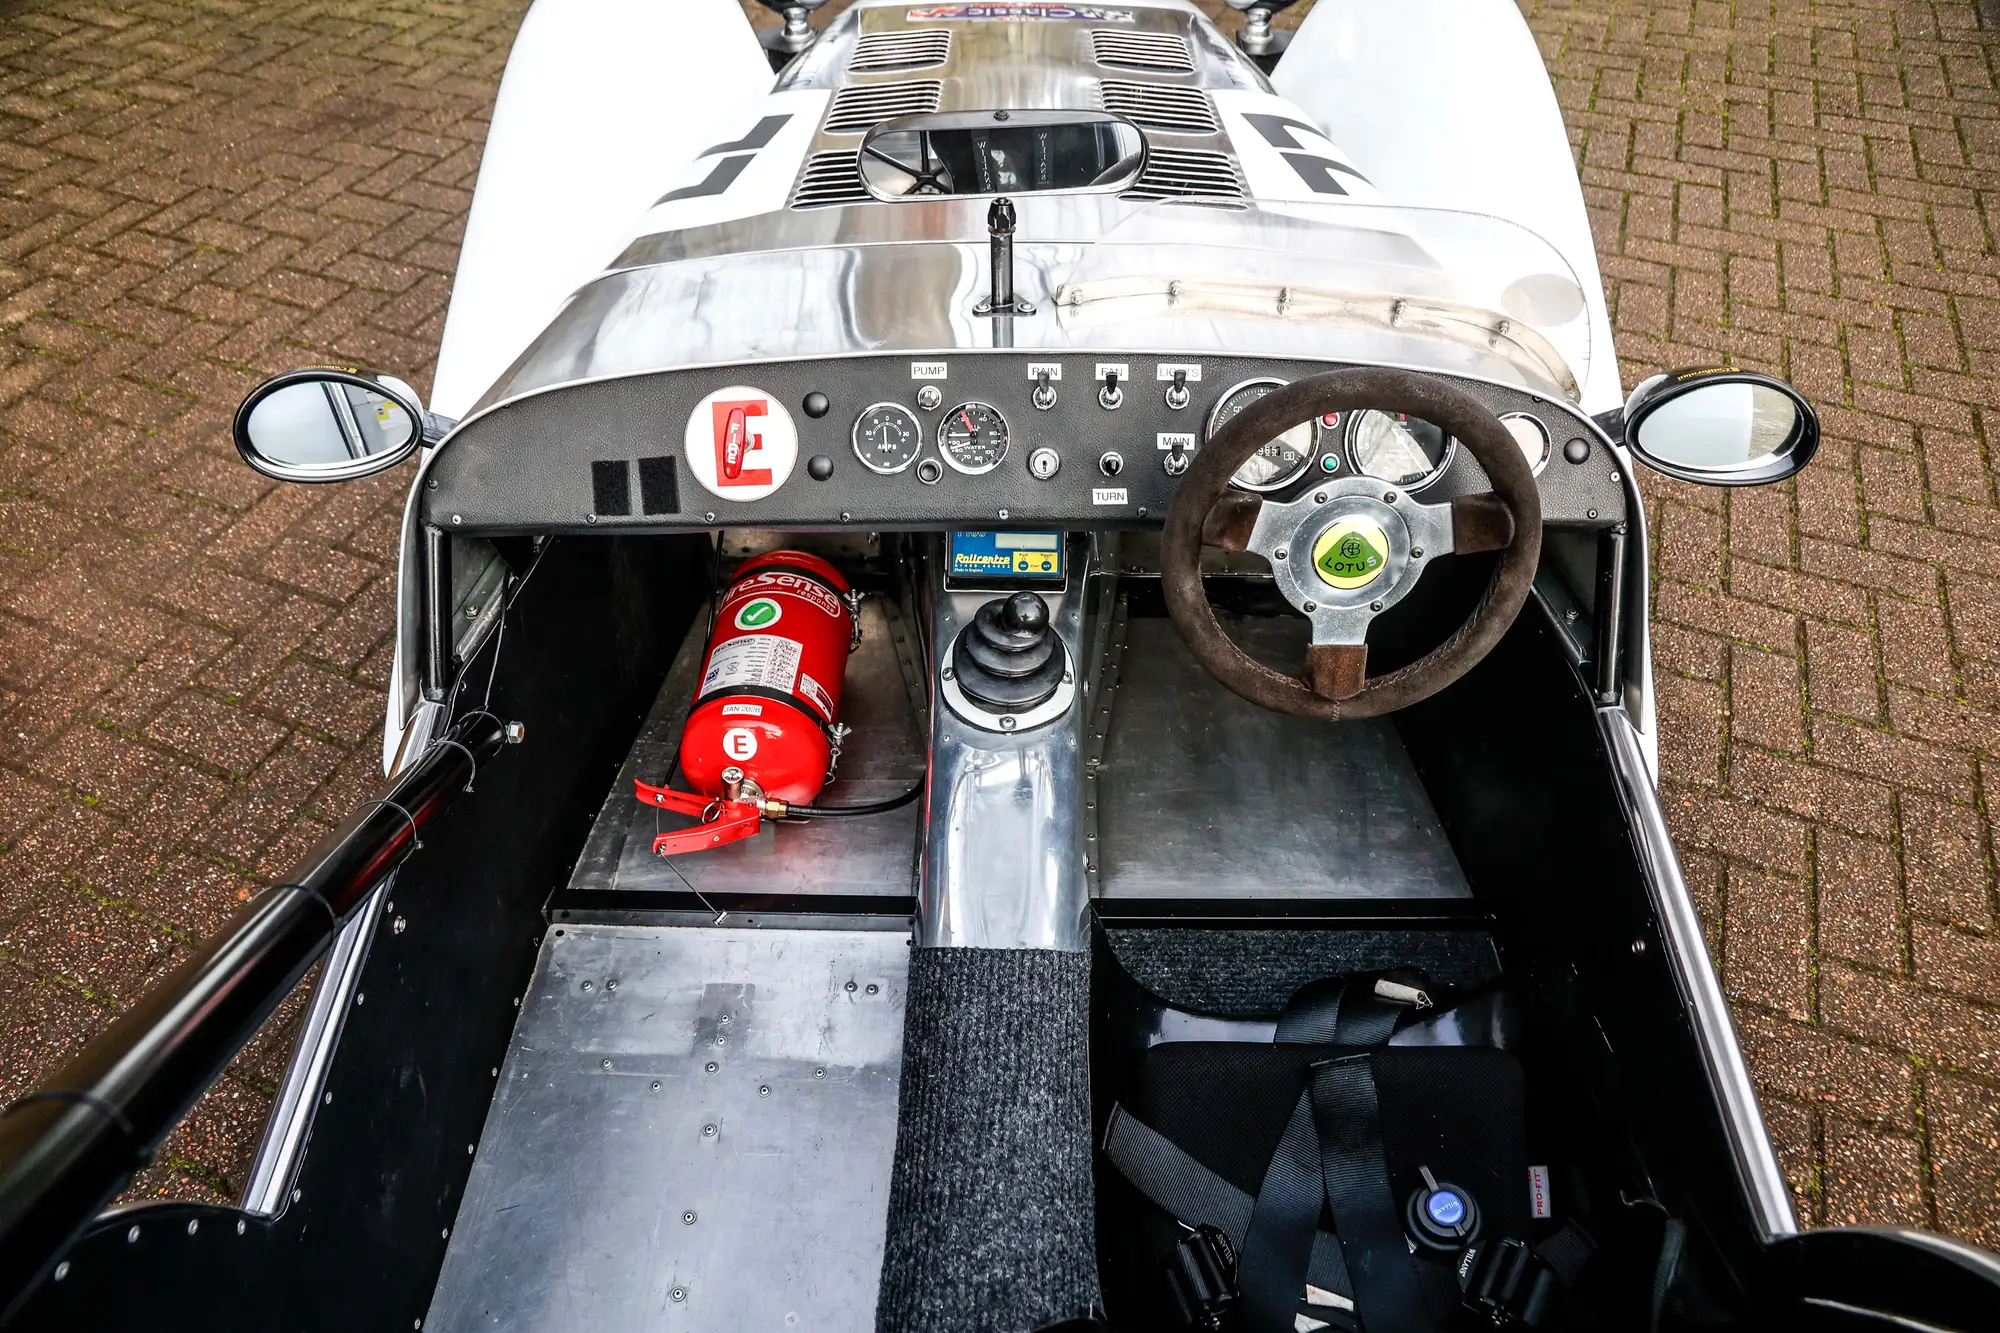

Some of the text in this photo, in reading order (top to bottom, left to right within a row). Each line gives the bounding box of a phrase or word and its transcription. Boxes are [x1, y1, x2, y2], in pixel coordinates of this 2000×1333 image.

[913, 366, 945, 376] PUMP
[1159, 367, 1199, 378] LIGTS
[727, 422, 741, 465] FIRE
[1162, 437, 1190, 446] MAIN
[1283, 451, 1295, 461] 130
[1095, 492, 1125, 501] TURN
[1324, 555, 1377, 574] LOTUS
[796, 589, 836, 615] response
[741, 705, 761, 713] 2028
[733, 735, 749, 754] E
[1458, 1248, 1477, 1278] WILLANS
